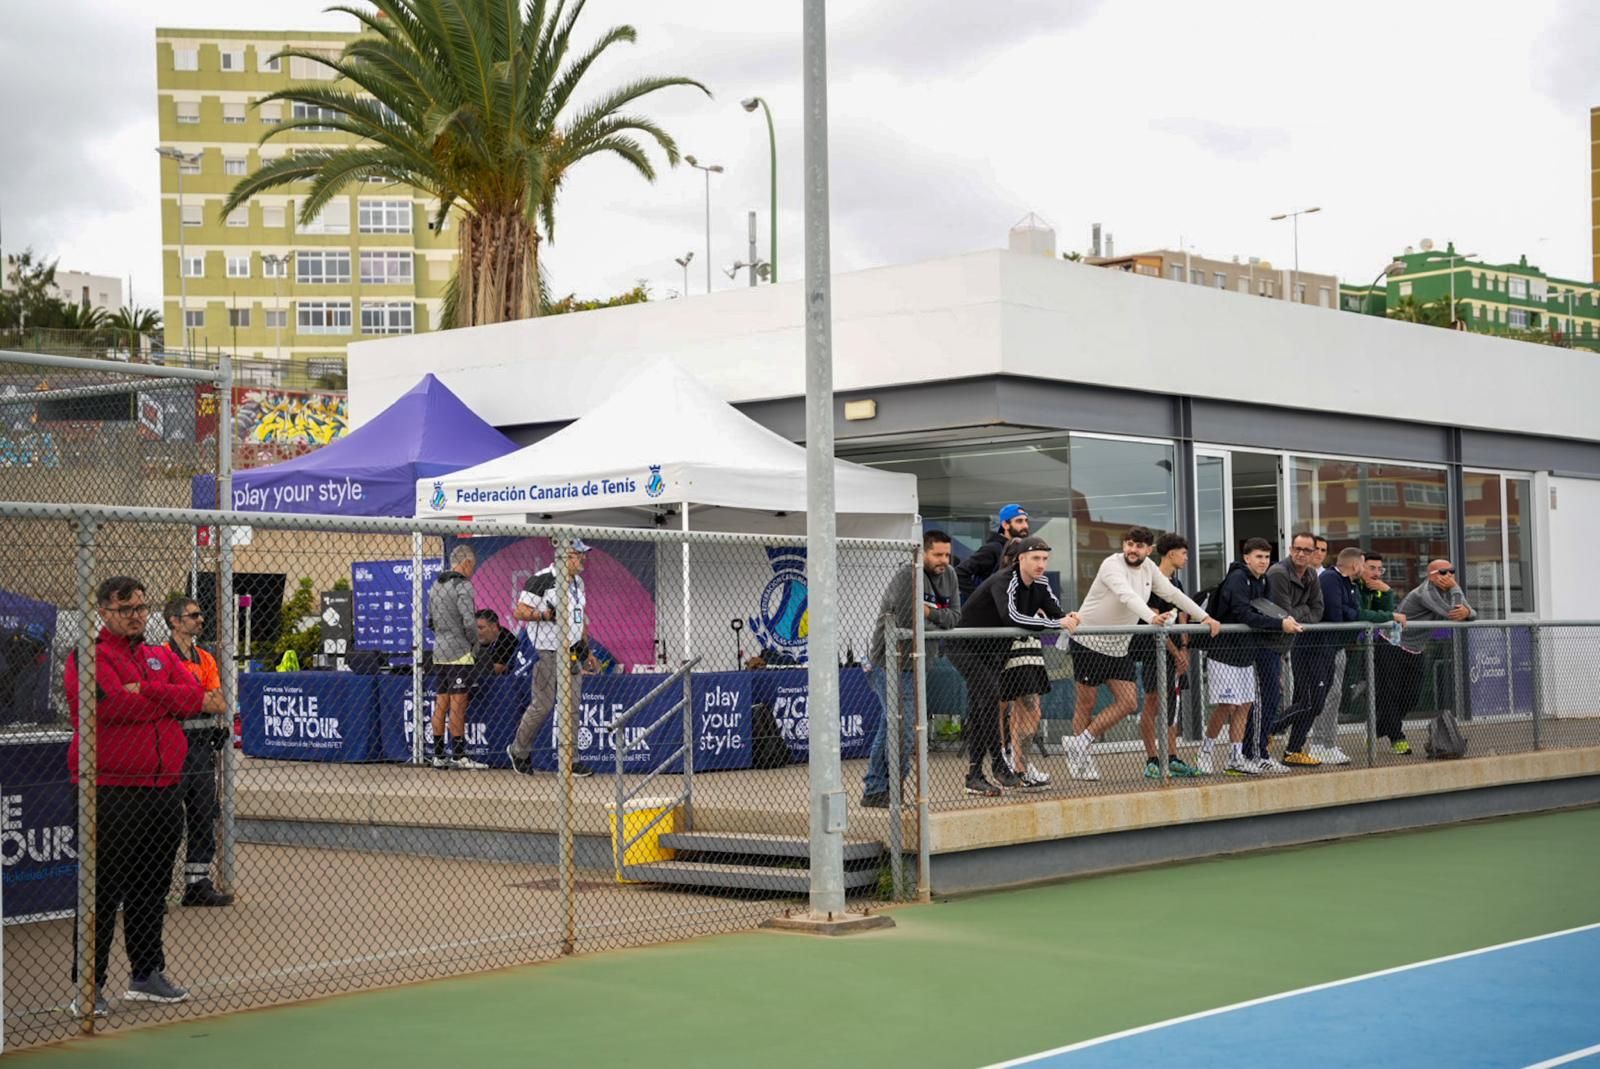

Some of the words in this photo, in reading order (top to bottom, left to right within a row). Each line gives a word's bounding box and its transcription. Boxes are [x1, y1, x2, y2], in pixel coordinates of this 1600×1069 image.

[234, 483, 270, 512] play
[273, 484, 314, 510] your
[456, 486, 526, 503] Federación
[529, 482, 579, 500] Canaria
[582, 480, 599, 496] de
[601, 477, 636, 494] Tenis
[263, 694, 319, 717] PICKLE
[704, 685, 740, 712] play
[701, 712, 742, 734] your
[0, 825, 79, 866] OUR
